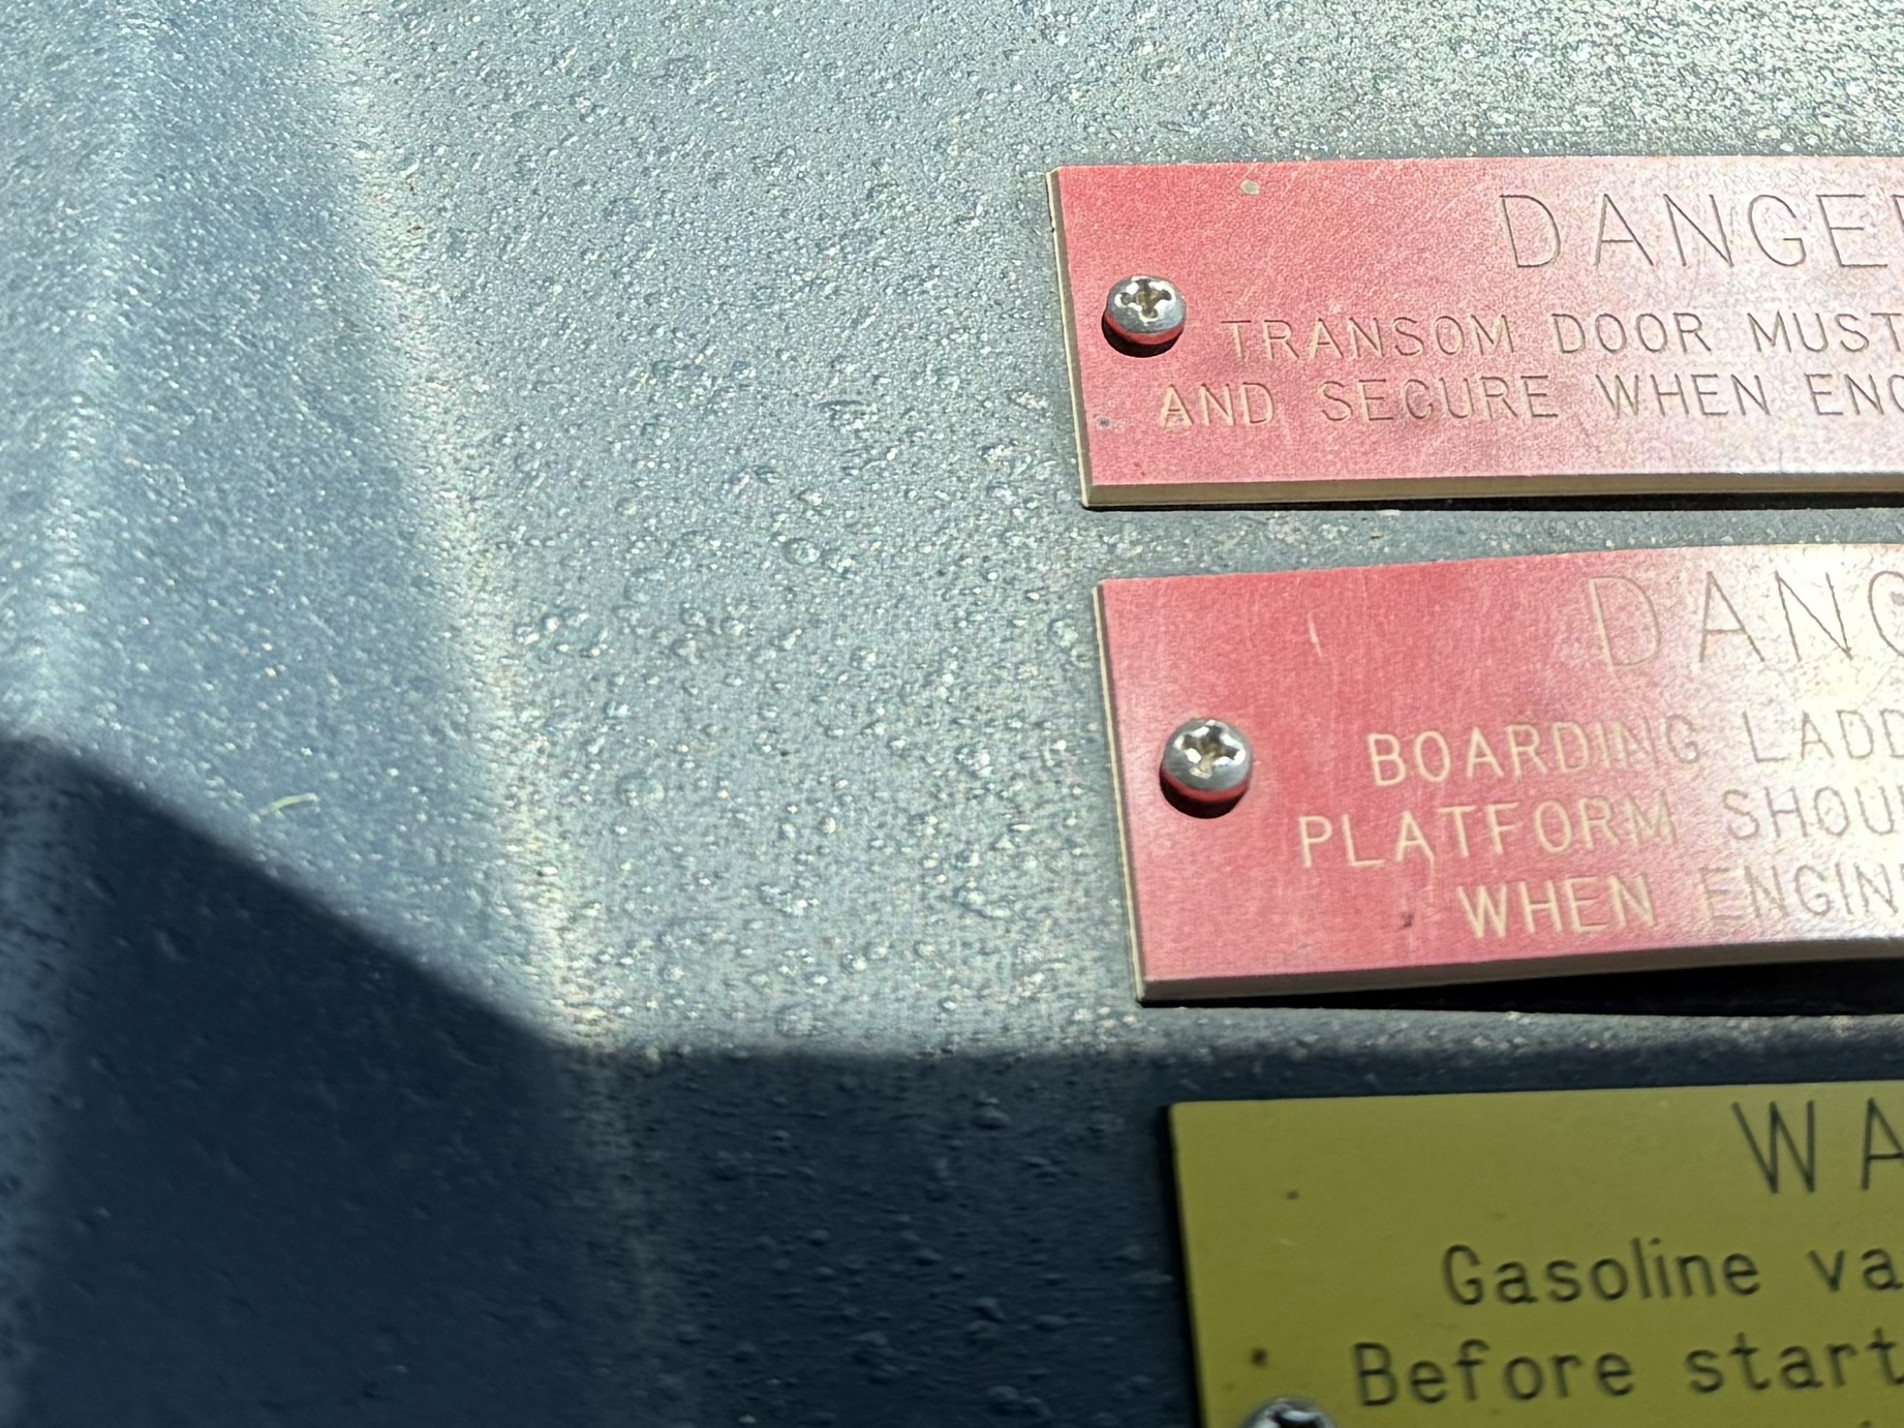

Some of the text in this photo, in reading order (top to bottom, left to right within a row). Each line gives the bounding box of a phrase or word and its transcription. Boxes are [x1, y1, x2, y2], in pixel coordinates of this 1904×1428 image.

[1221, 312, 1514, 362] TRANSOM
[1552, 311, 1712, 356] DOOR
[1747, 311, 1902, 354] MUST
[1159, 382, 1276, 431] AND
[1320, 374, 1558, 423] SECURE
[1596, 373, 1771, 419] WHEN
[1368, 714, 1701, 787] BOARDING
[1299, 790, 1678, 868] PLATFORM
[1456, 872, 1656, 939] WHEN
[1442, 1237, 1761, 1306] Gasoline
[1352, 1338, 1635, 1407] Before
